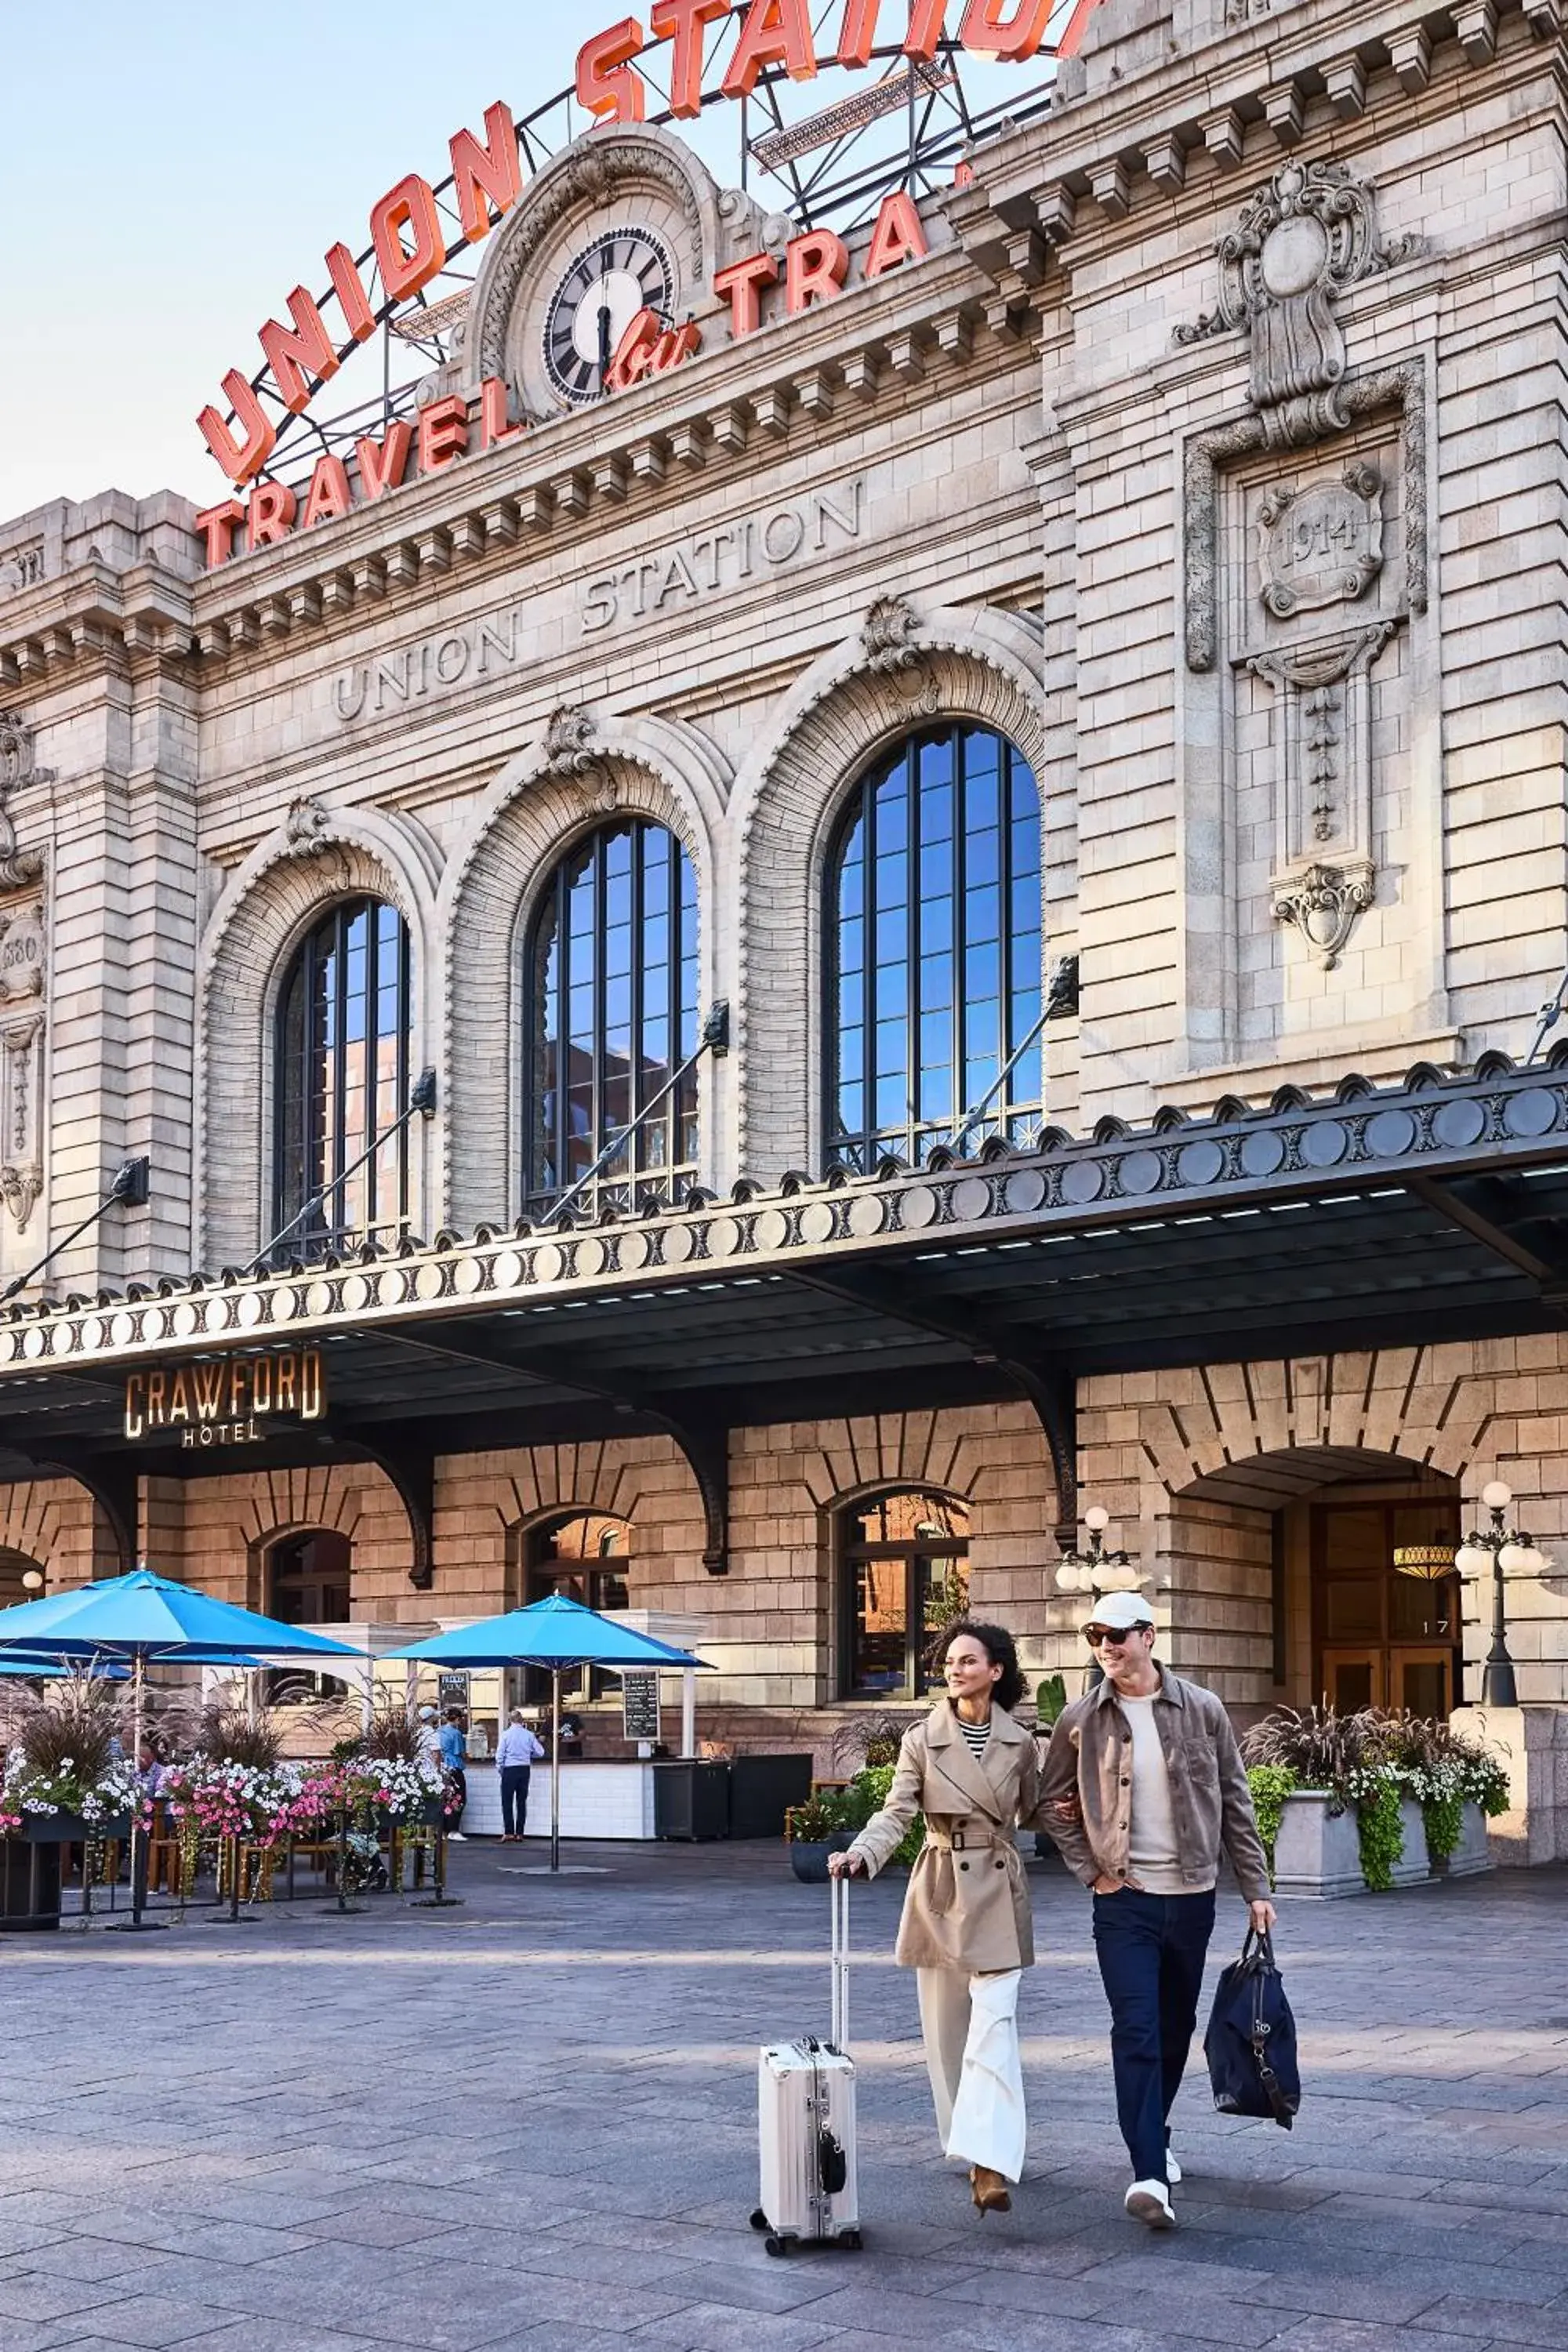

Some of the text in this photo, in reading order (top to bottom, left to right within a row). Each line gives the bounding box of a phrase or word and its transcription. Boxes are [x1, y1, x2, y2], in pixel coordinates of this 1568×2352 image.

[196, 100, 523, 488] UNION
[196, 376, 526, 565] TRAVEL
[1280, 507, 1358, 568] 1914
[335, 480, 862, 722] UNION STATION
[125, 1350, 321, 1439] CRAWFORD
[182, 1420, 260, 1447] HOTEL
